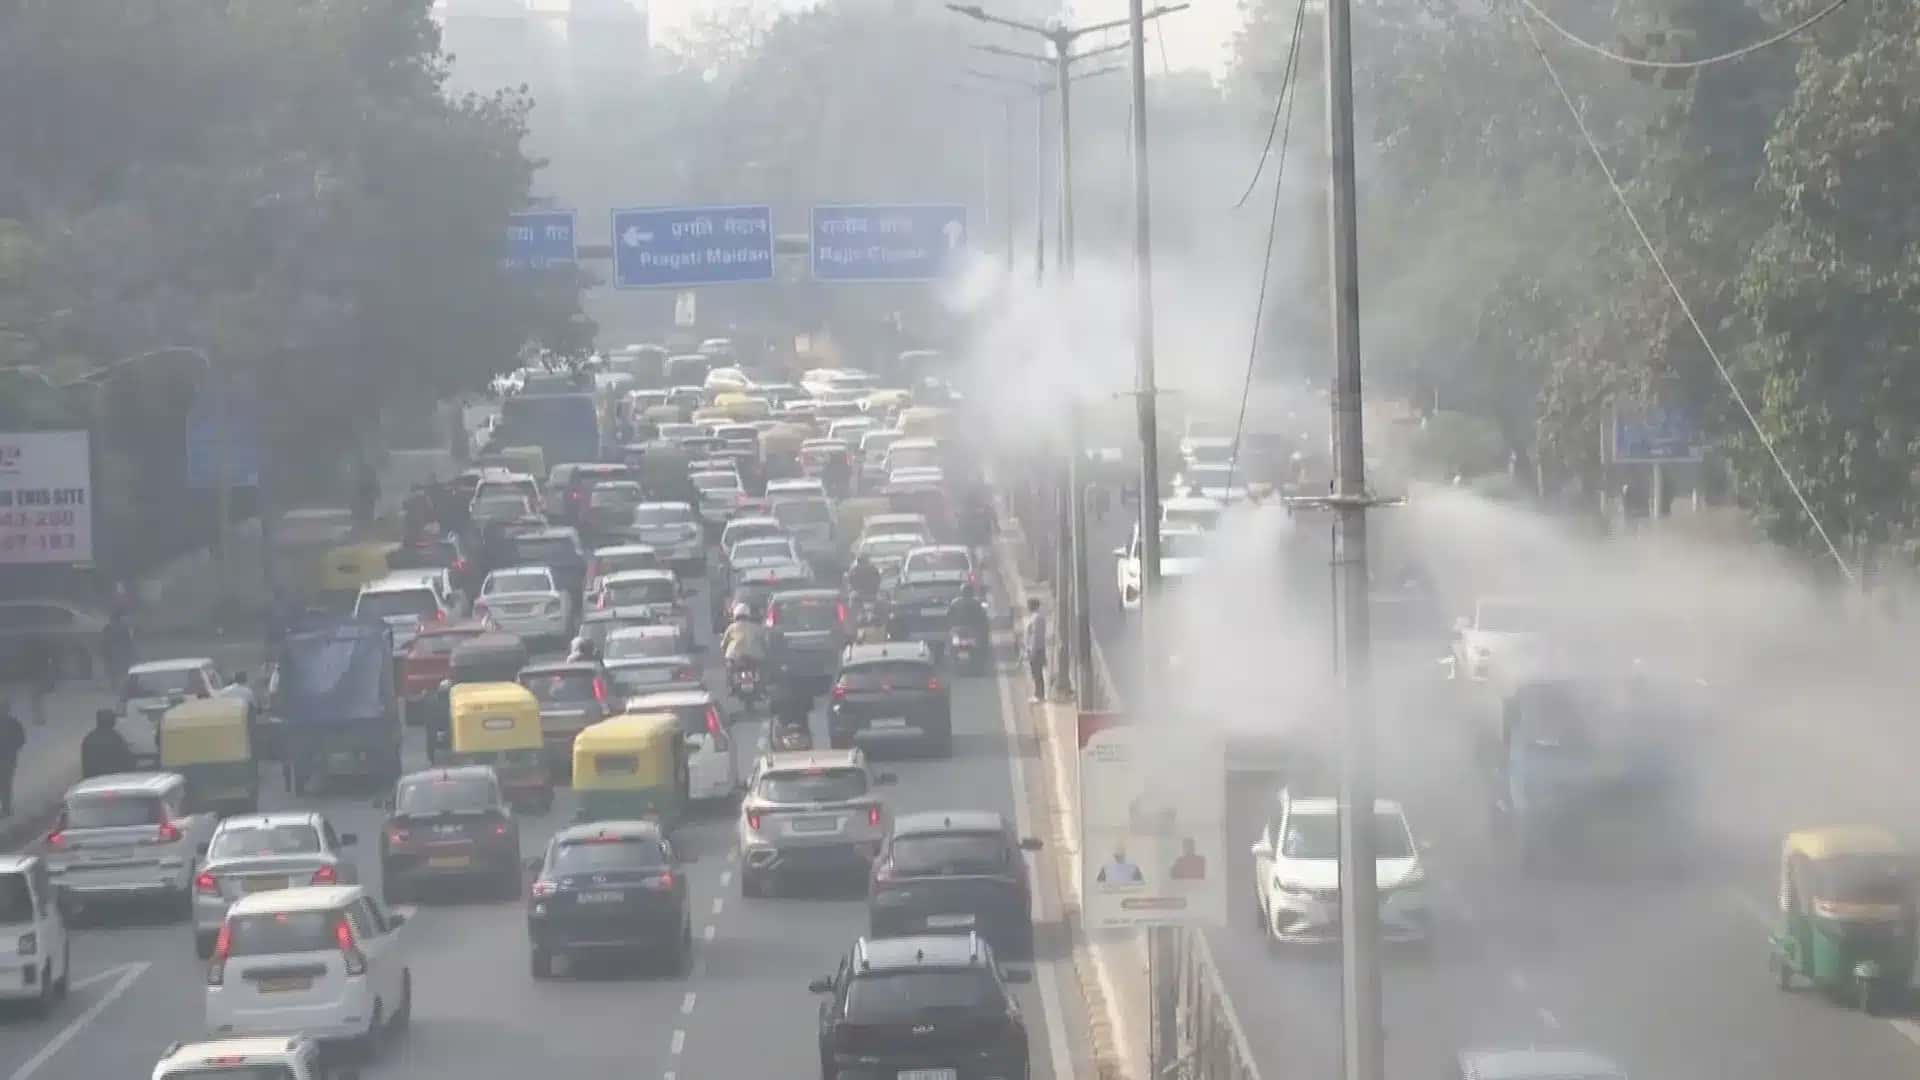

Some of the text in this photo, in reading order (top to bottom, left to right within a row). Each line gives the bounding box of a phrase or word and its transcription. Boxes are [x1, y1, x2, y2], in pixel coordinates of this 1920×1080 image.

[640, 247, 769, 270] Pragati Maidan
[52, 488, 84, 505] SITE
